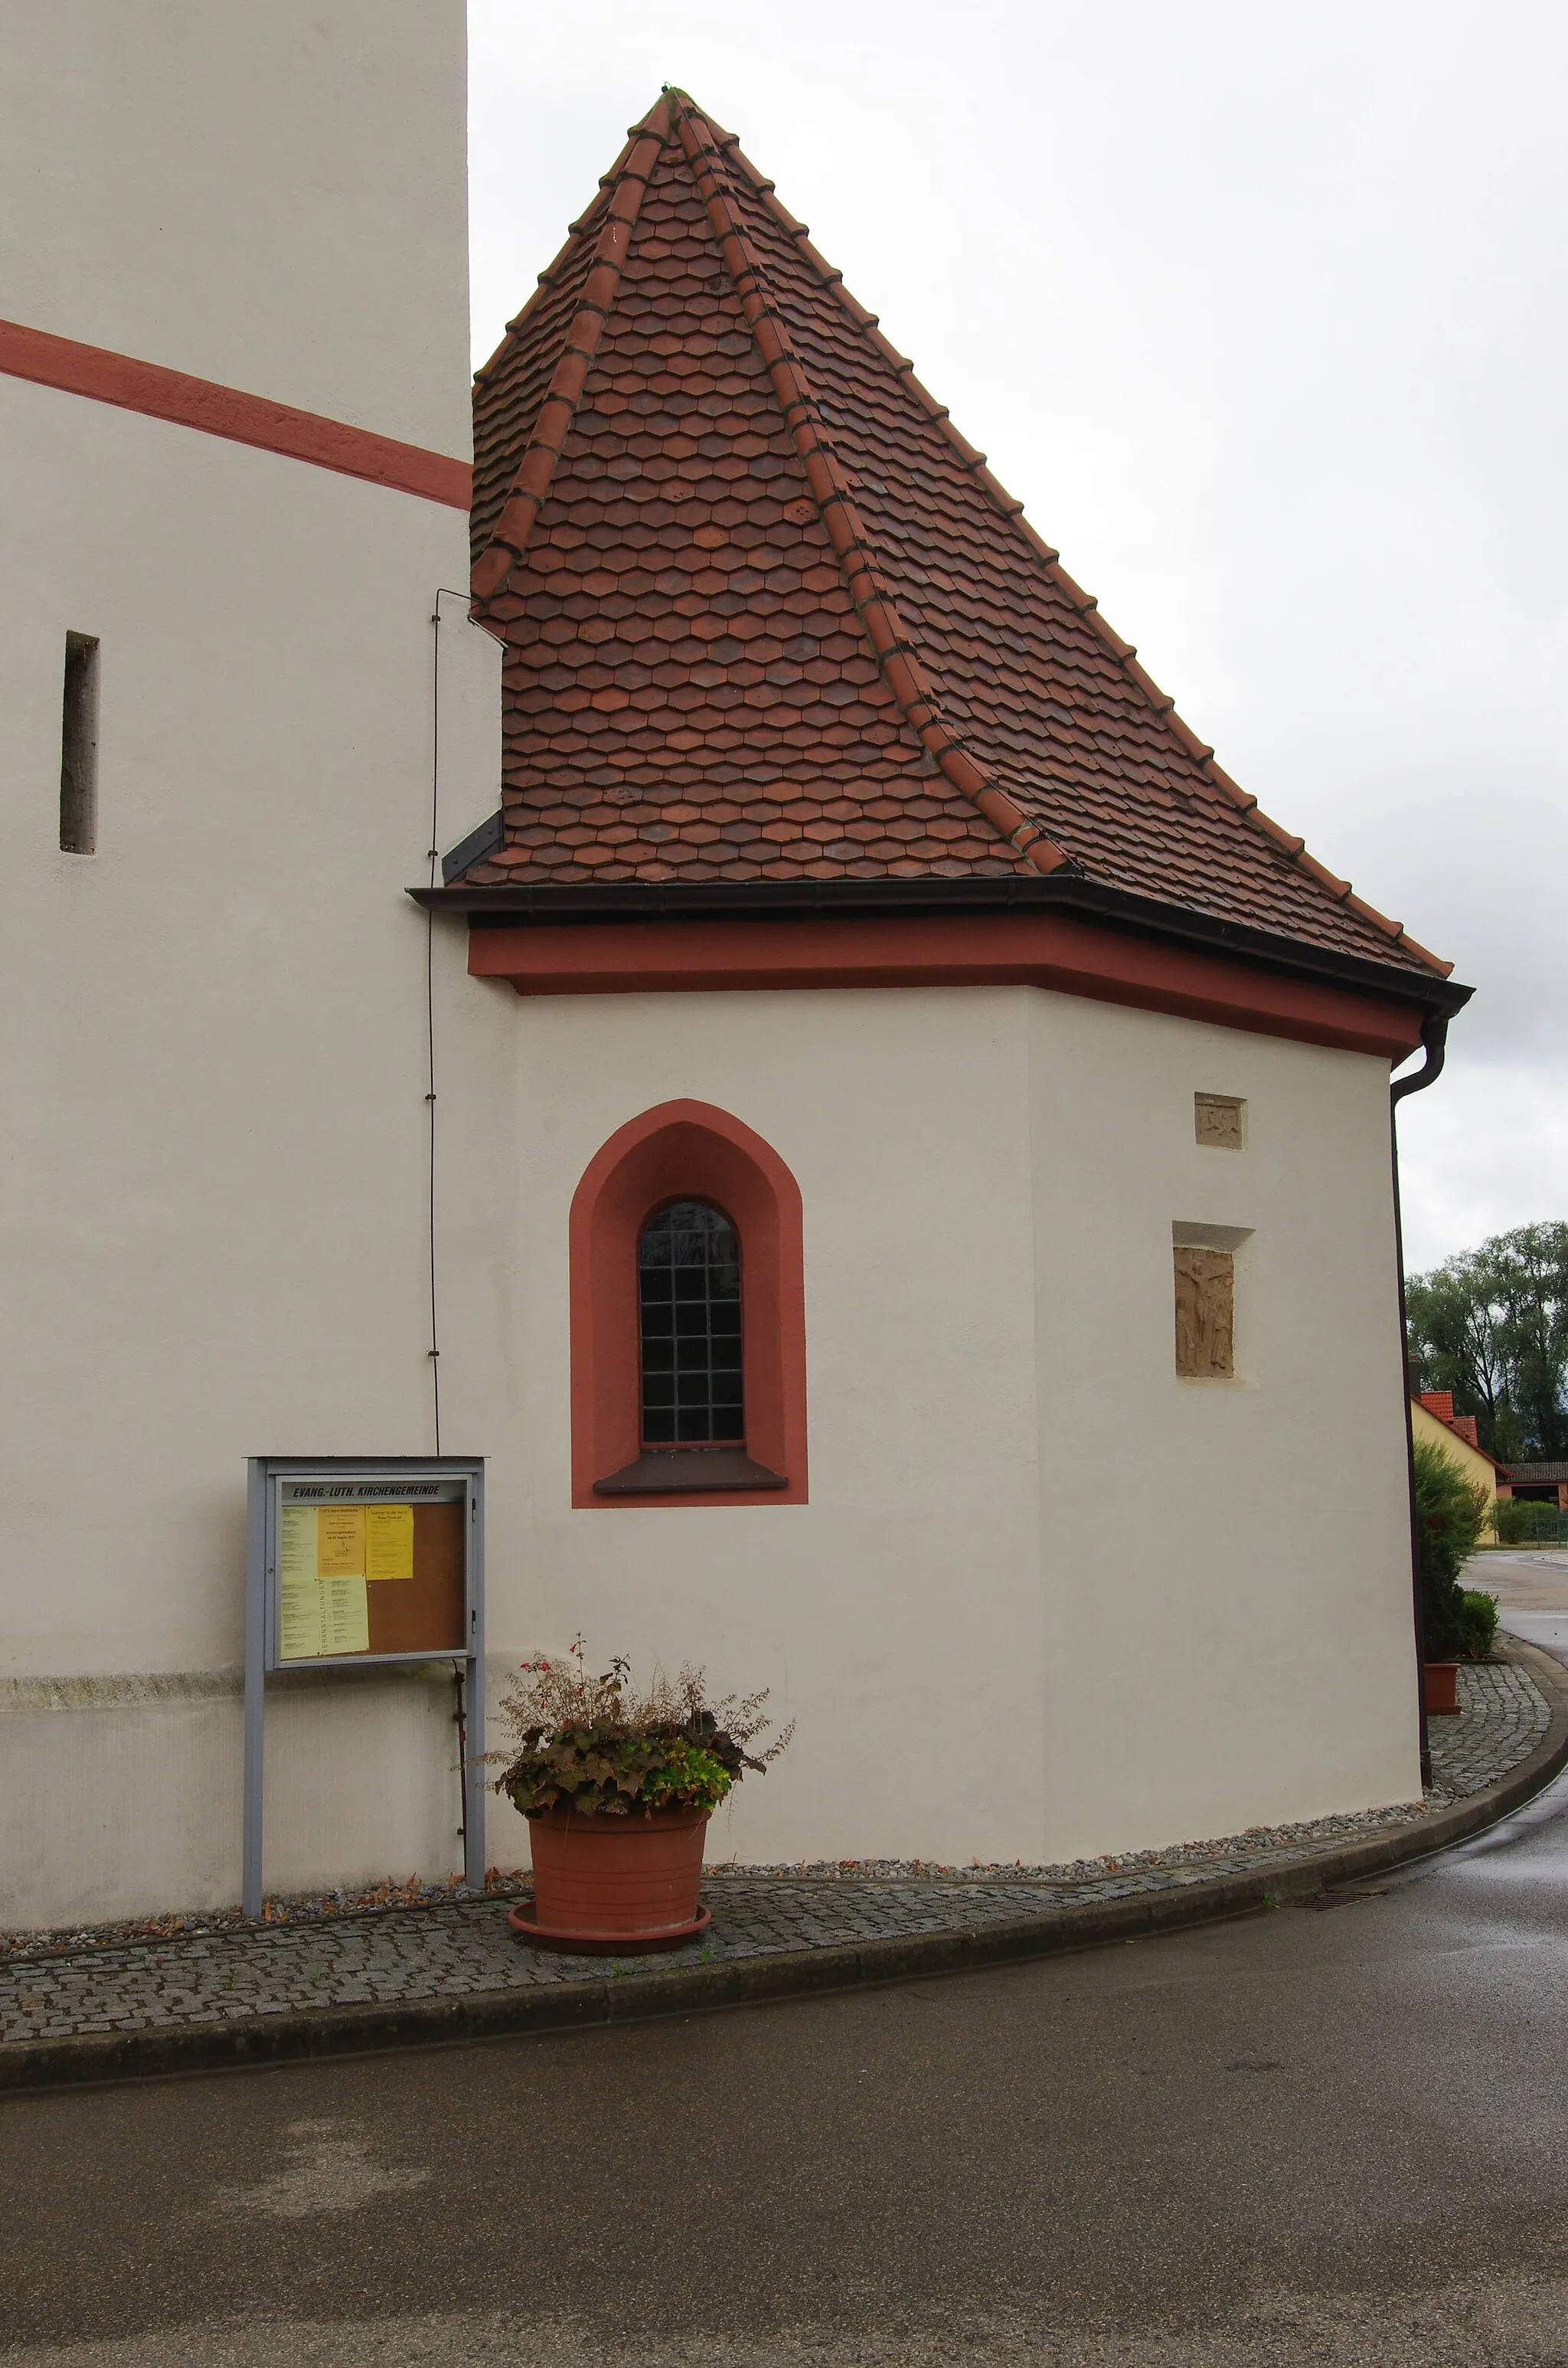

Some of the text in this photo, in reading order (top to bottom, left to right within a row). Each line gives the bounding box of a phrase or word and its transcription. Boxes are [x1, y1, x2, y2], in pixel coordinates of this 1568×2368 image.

[293, 1485, 440, 1497] EVANG.-LUTH. KIRCHENGEMEINDE
[318, 1579, 328, 1654] VERANSTALTUNGEN
